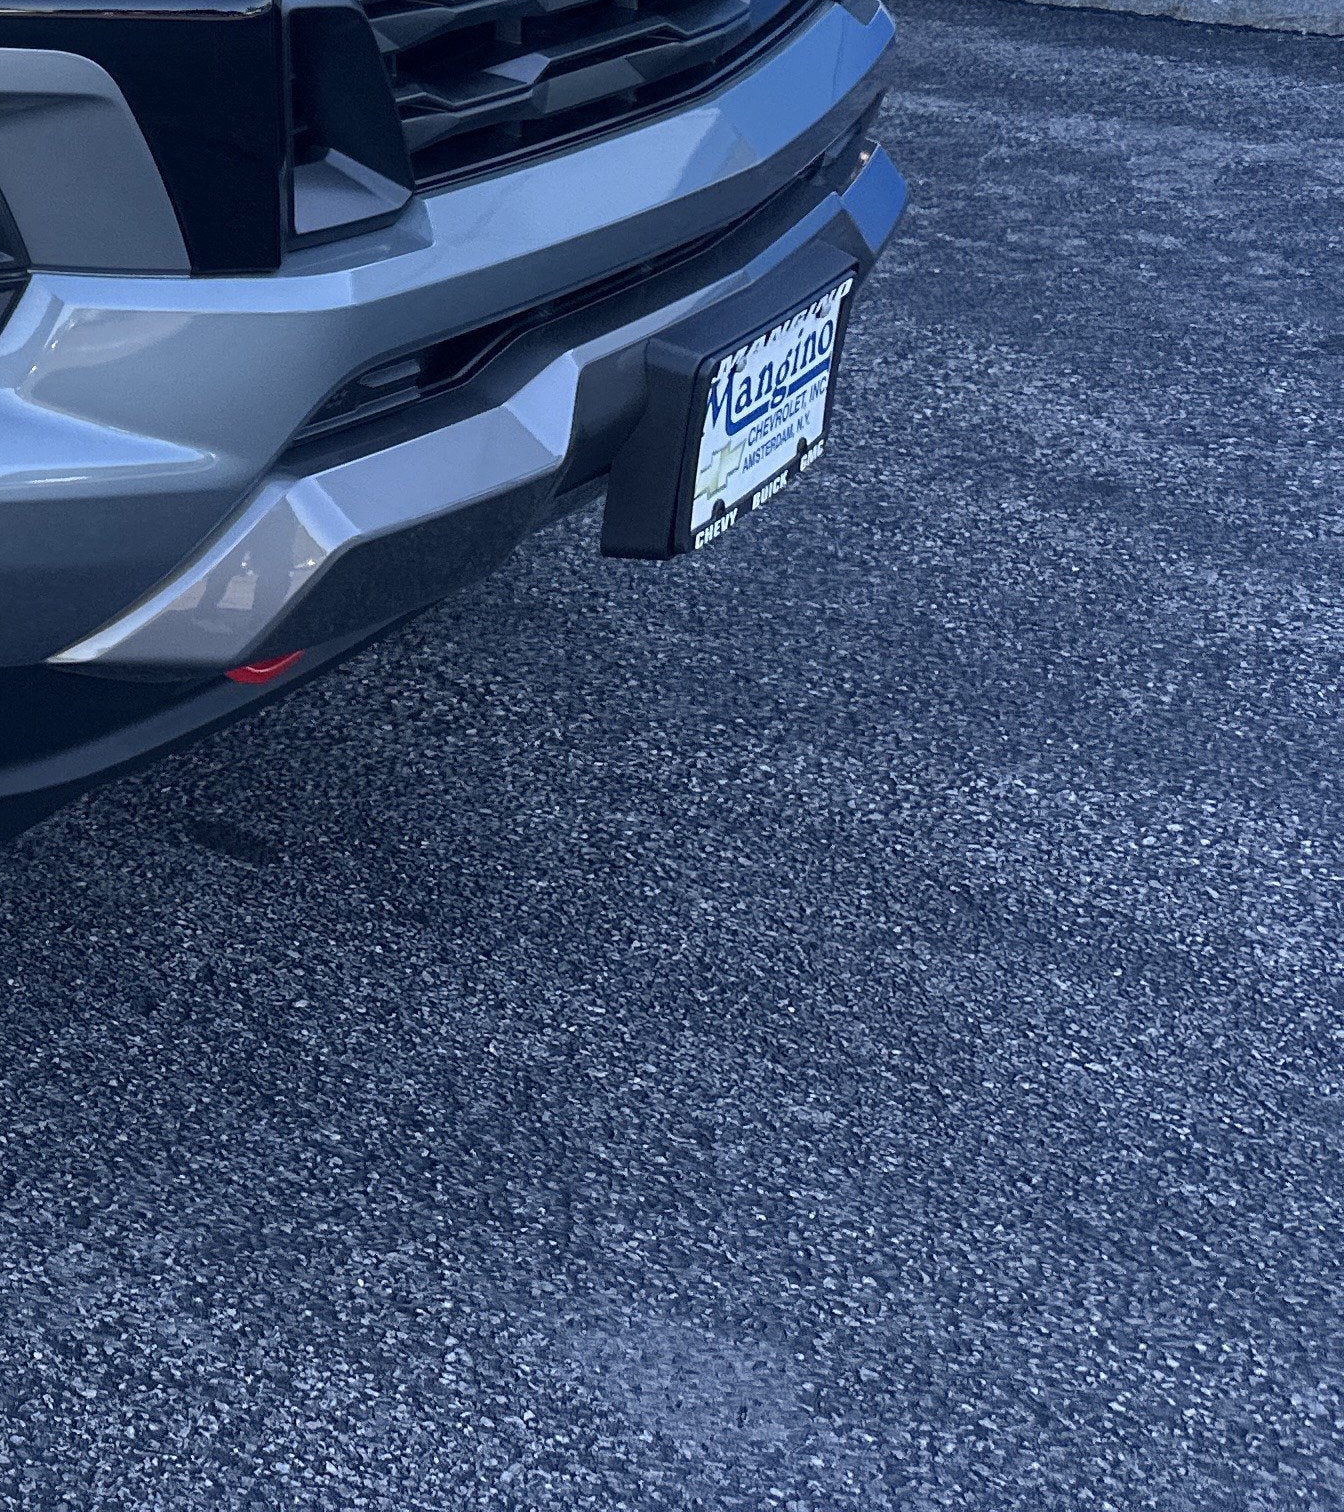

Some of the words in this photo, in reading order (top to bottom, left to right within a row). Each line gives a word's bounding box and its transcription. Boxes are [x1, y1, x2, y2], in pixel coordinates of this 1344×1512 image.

[708, 319, 834, 436] Mangino
[695, 508, 738, 549] CHEVY
[752, 470, 789, 510] BUICK
[800, 439, 825, 472] GMC
